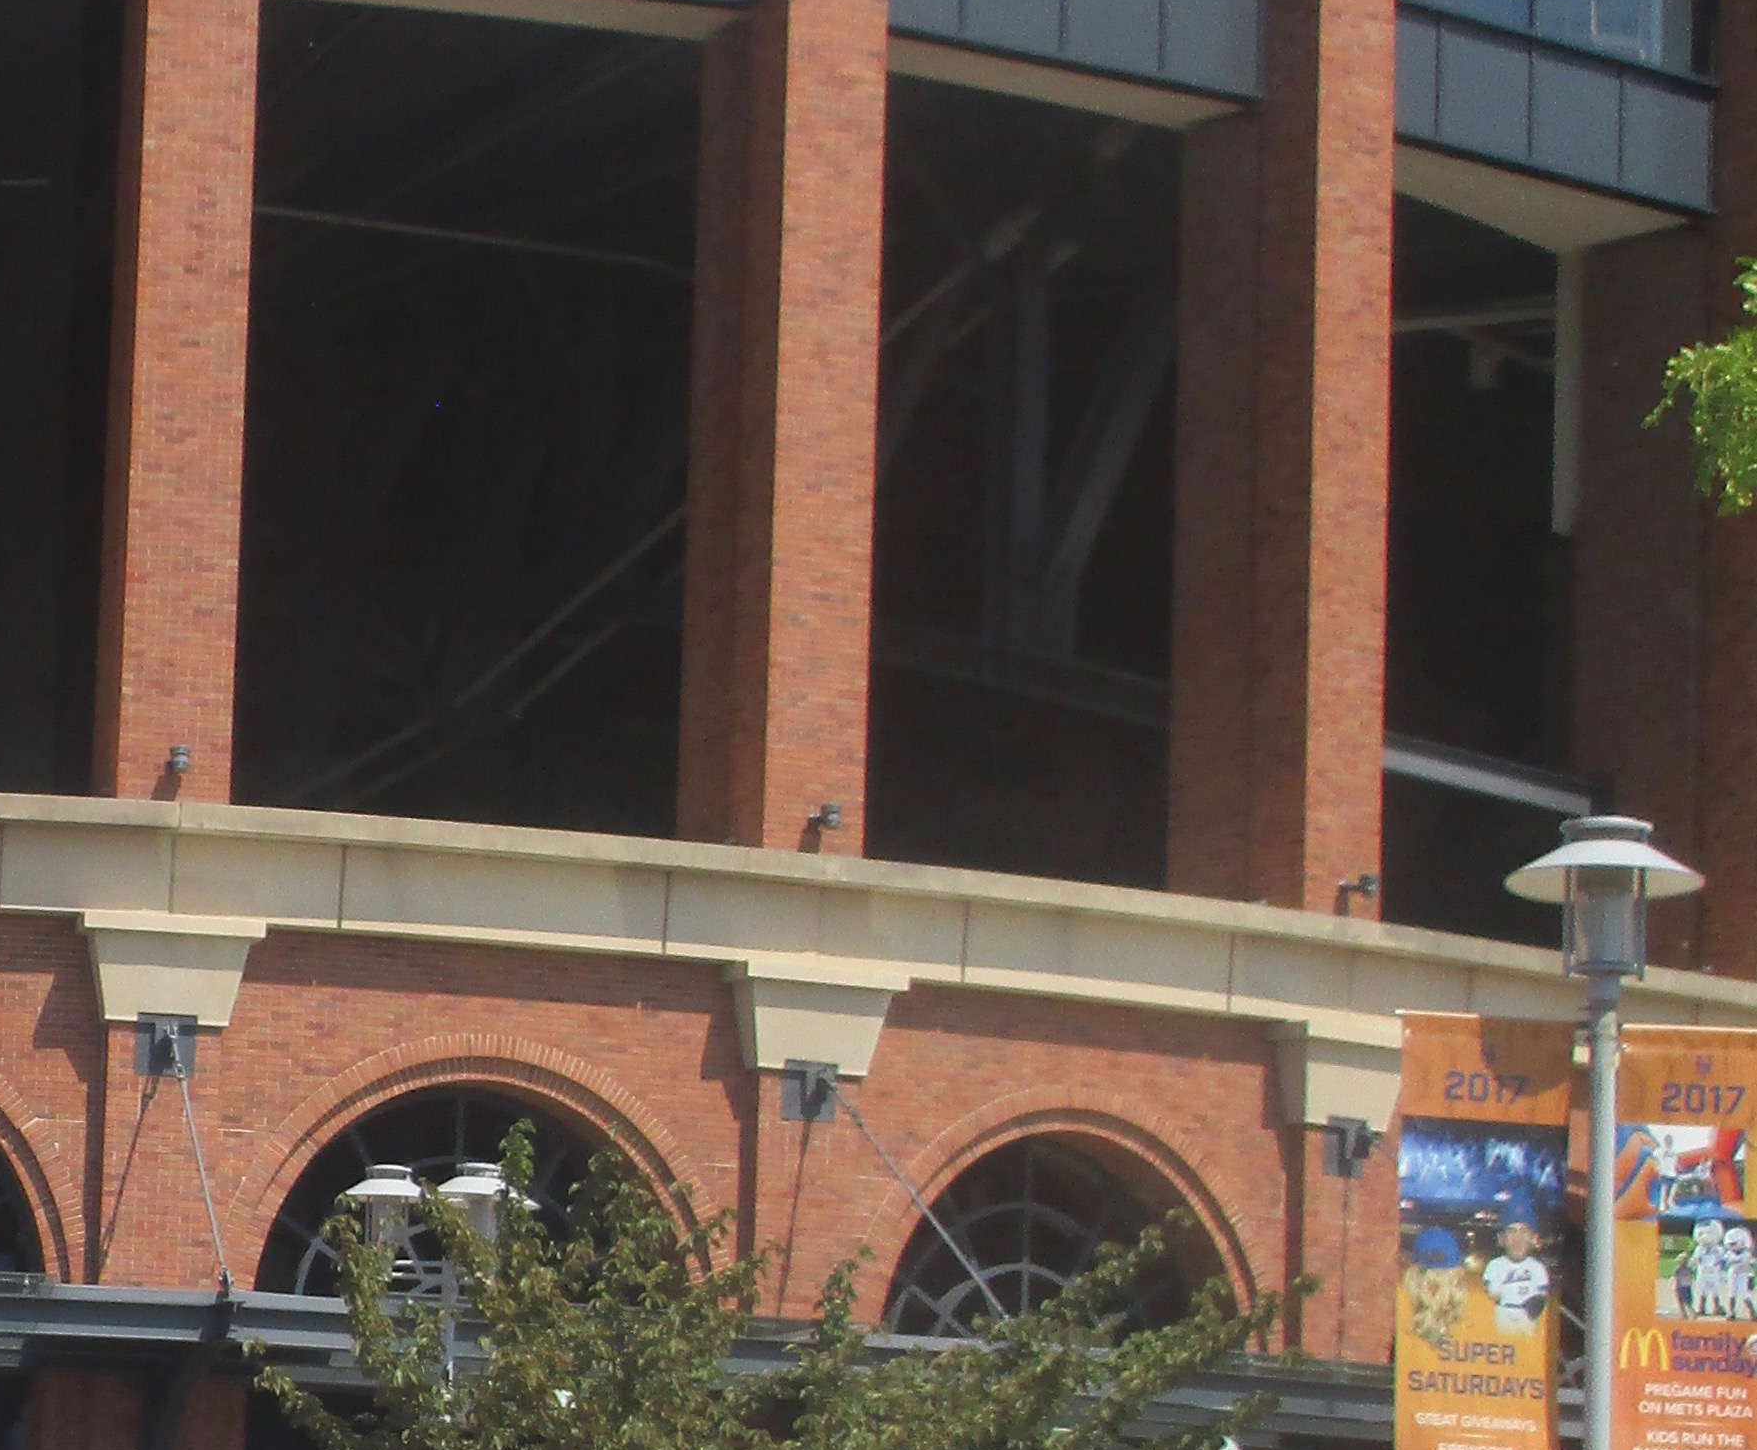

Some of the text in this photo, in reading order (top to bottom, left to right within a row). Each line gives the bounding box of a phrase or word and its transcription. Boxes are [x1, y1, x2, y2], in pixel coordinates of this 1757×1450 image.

[1445, 1070, 1529, 1105] 2017
[1661, 1082, 1747, 1116] 2017
[1438, 1340, 1516, 1366] SUPER
[1672, 1330, 1745, 1358] family
[1408, 1370, 1545, 1400] SATURDAYS
[1644, 1383, 1748, 1400] PREGAME FUN
[1414, 1412, 1537, 1433] GREAT GIVEAWAYS
[1638, 1401, 1753, 1419] ON METS PLAZA
[1646, 1430, 1745, 1448] KIDS RUN THE
